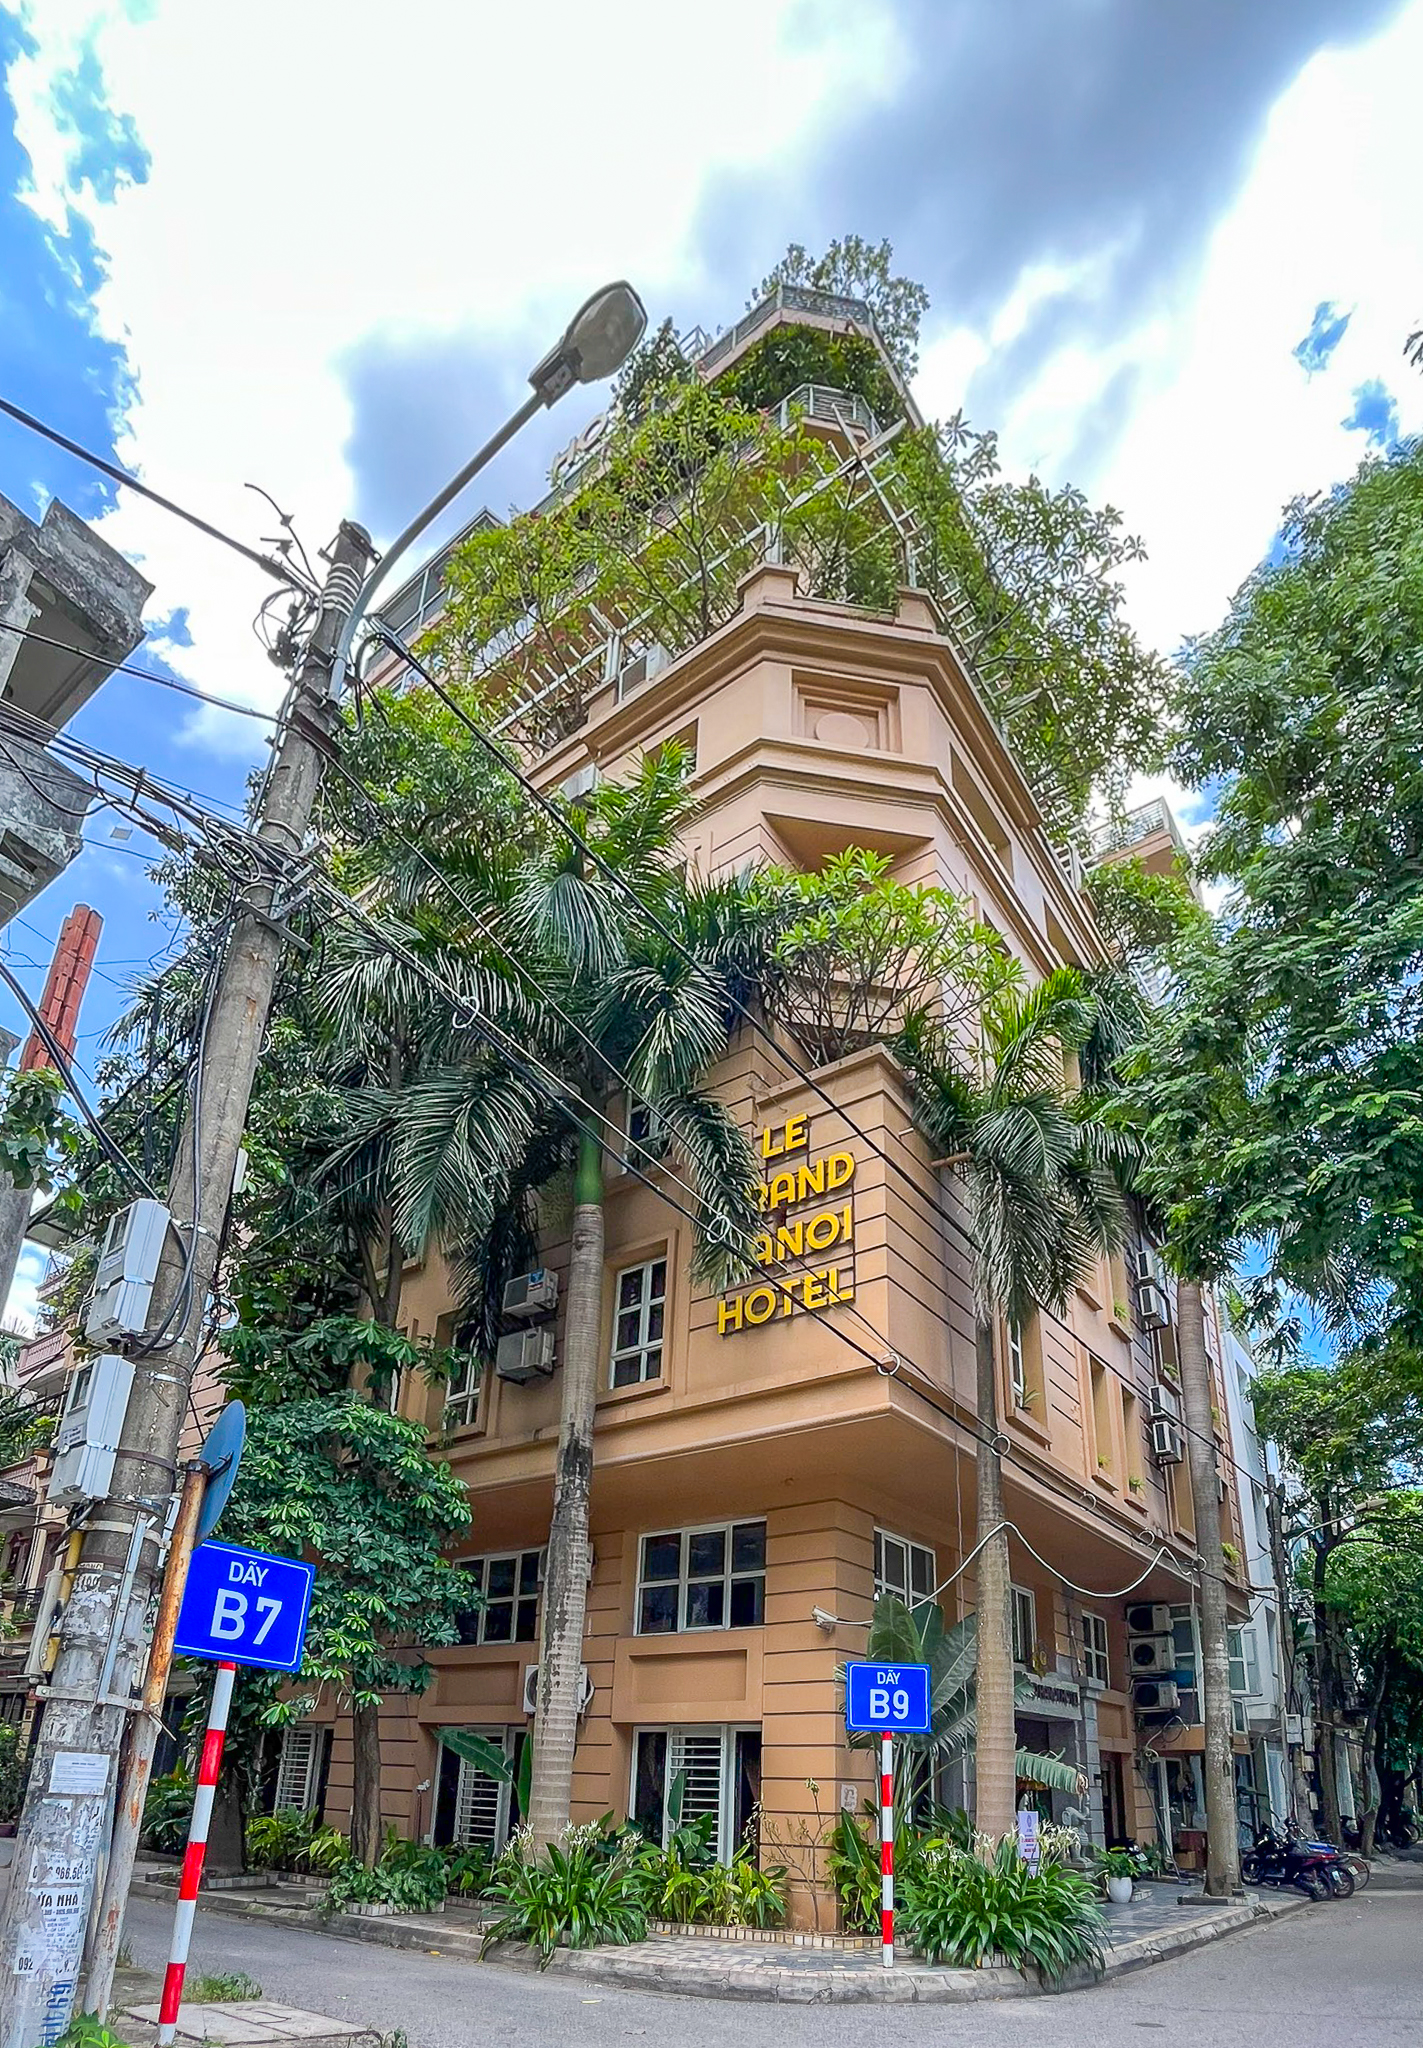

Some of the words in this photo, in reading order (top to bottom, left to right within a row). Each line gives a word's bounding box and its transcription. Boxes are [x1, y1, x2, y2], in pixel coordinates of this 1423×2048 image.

[762, 1113, 808, 1159] LE
[754, 1152, 855, 1213] RAND
[753, 1204, 853, 1266] ANOI
[717, 1267, 855, 1335] HOTEL
[228, 1560, 270, 1588] DÃY
[210, 1587, 283, 1646] B7
[877, 1669, 901, 1685] DÃY
[869, 1688, 909, 1720] B9
